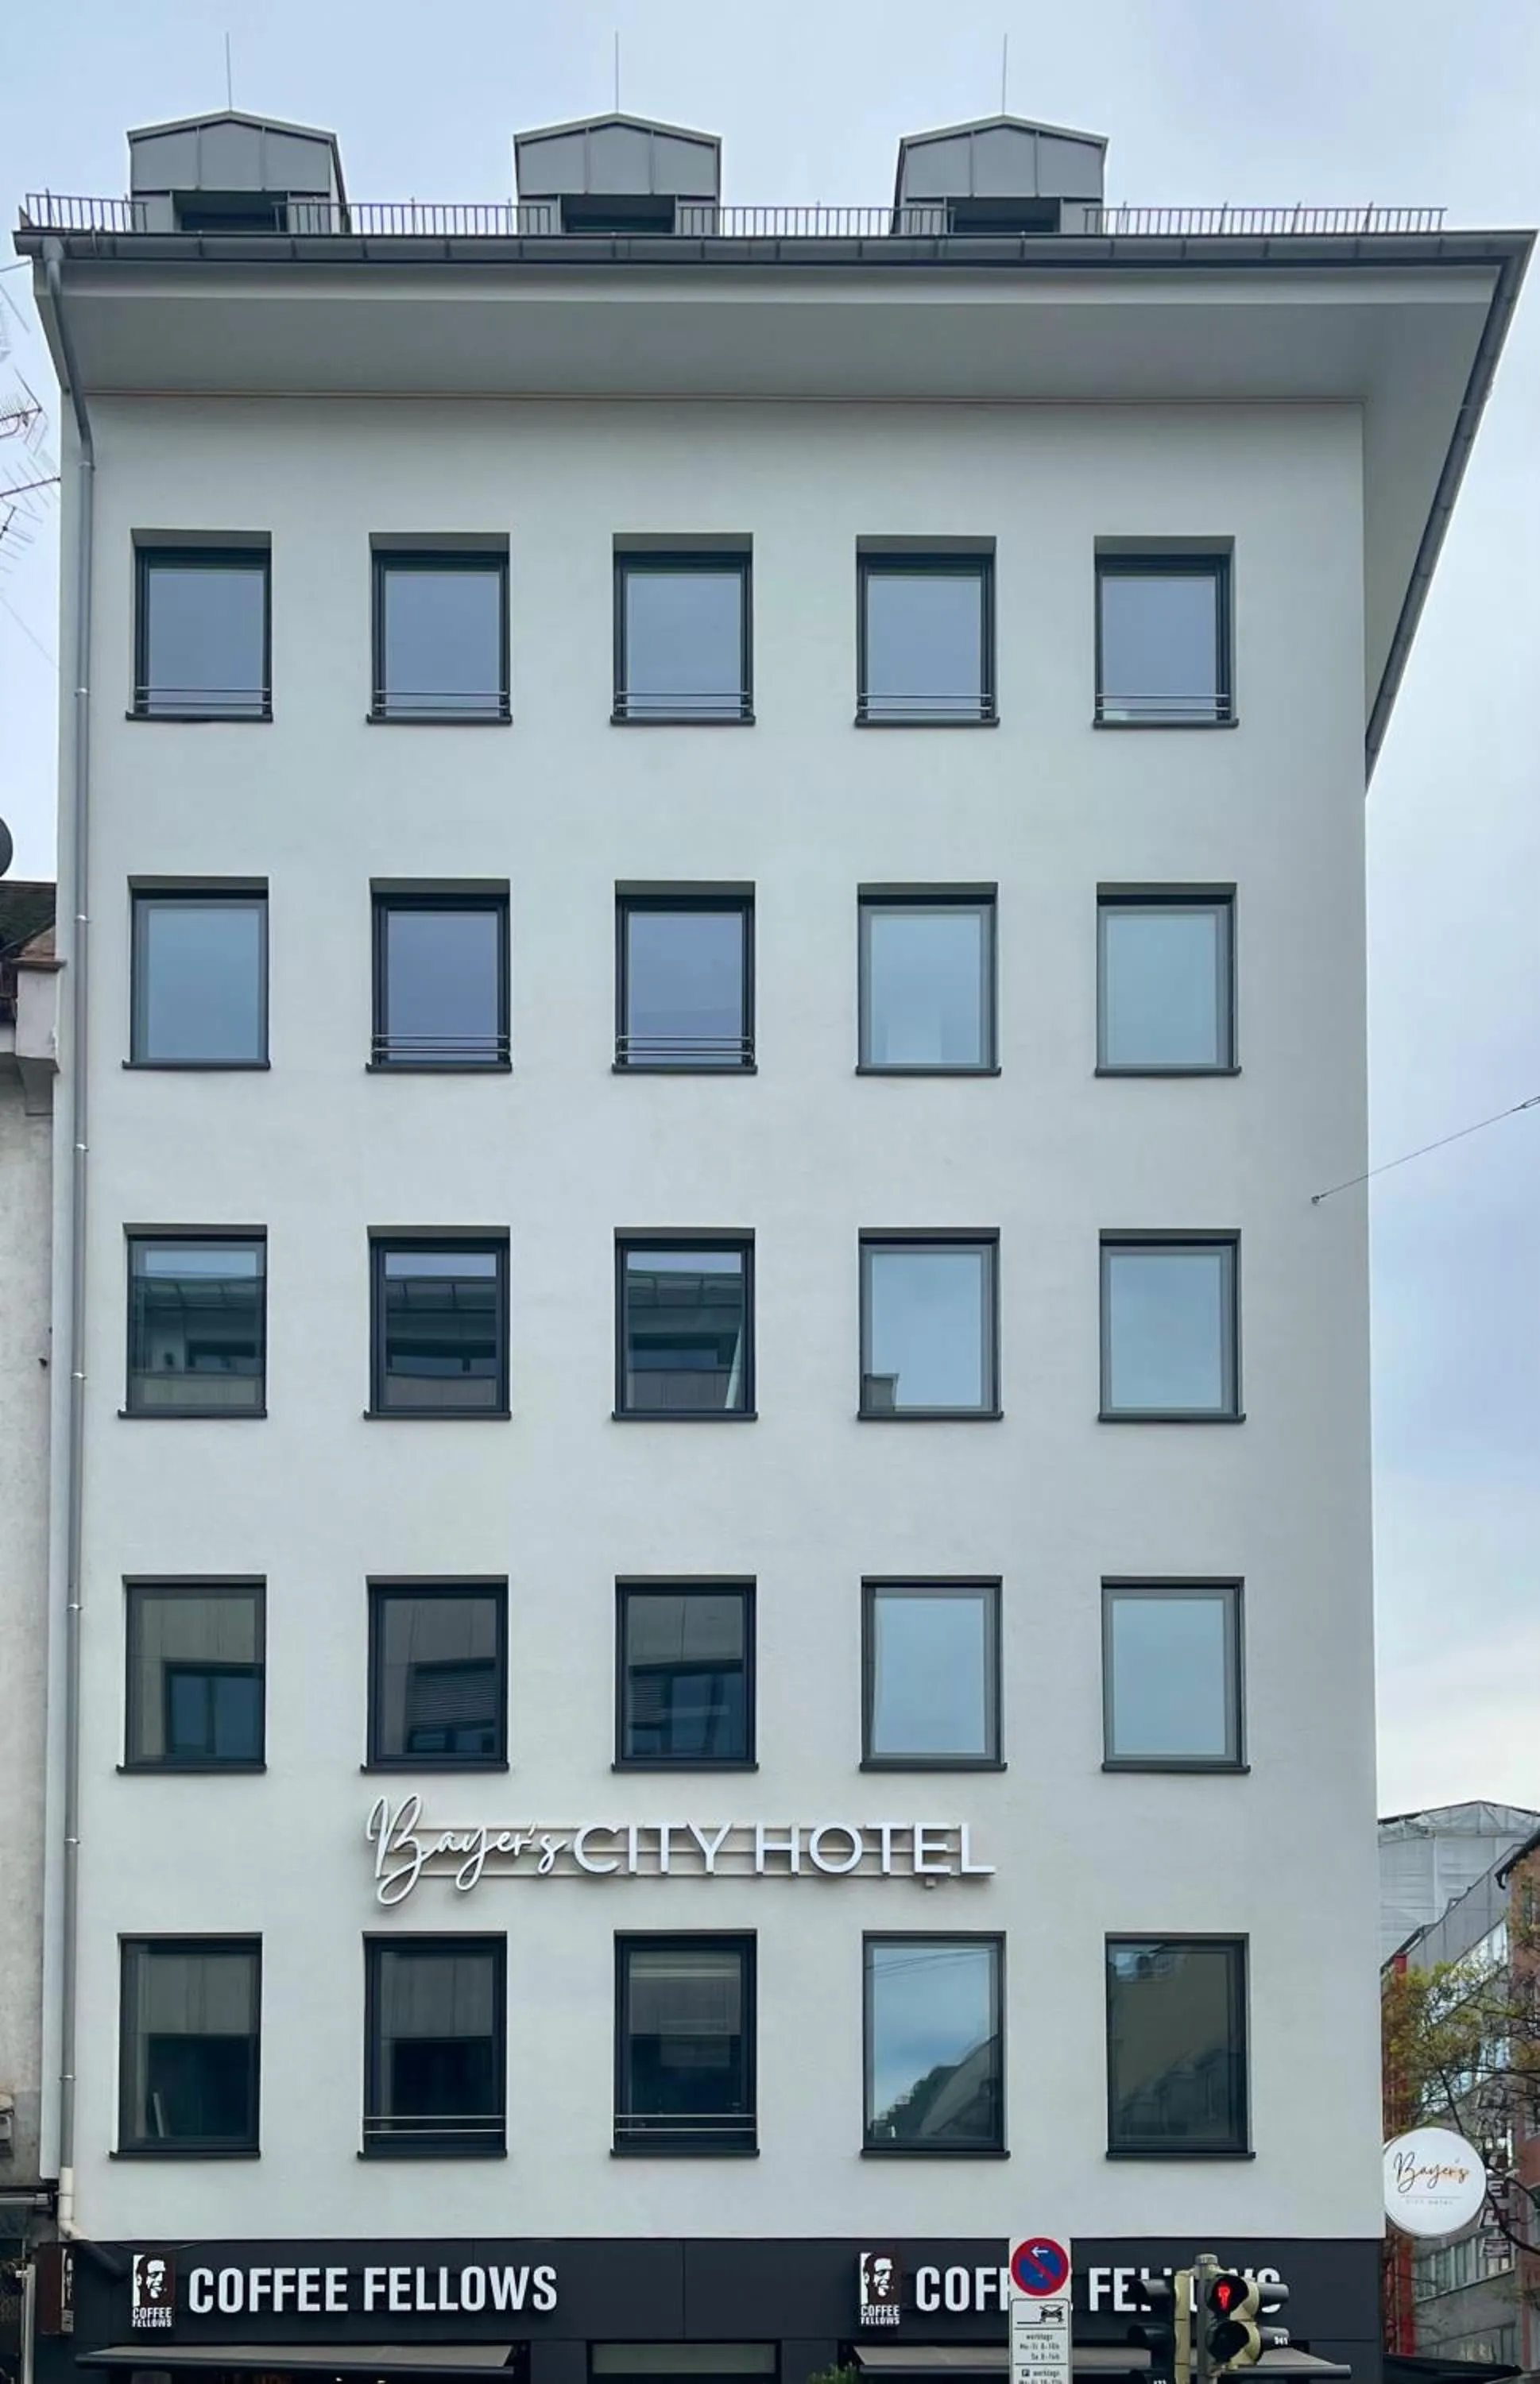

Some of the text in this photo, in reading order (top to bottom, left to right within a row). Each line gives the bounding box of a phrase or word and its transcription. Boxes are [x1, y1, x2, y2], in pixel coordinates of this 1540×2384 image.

[366, 1793, 996, 1906] Bayer's CITY HOTEL
[1393, 2151, 1469, 2193] Bayer's
[188, 2266, 557, 2313] COFFEE FELLOWS
[916, 2266, 1073, 2312] COFF
[132, 2318, 172, 2328] FELLOWS
[133, 2307, 172, 2319] COFFEE
[861, 2305, 900, 2316] COFFEE
[861, 2316, 900, 2325] FELLOWS
